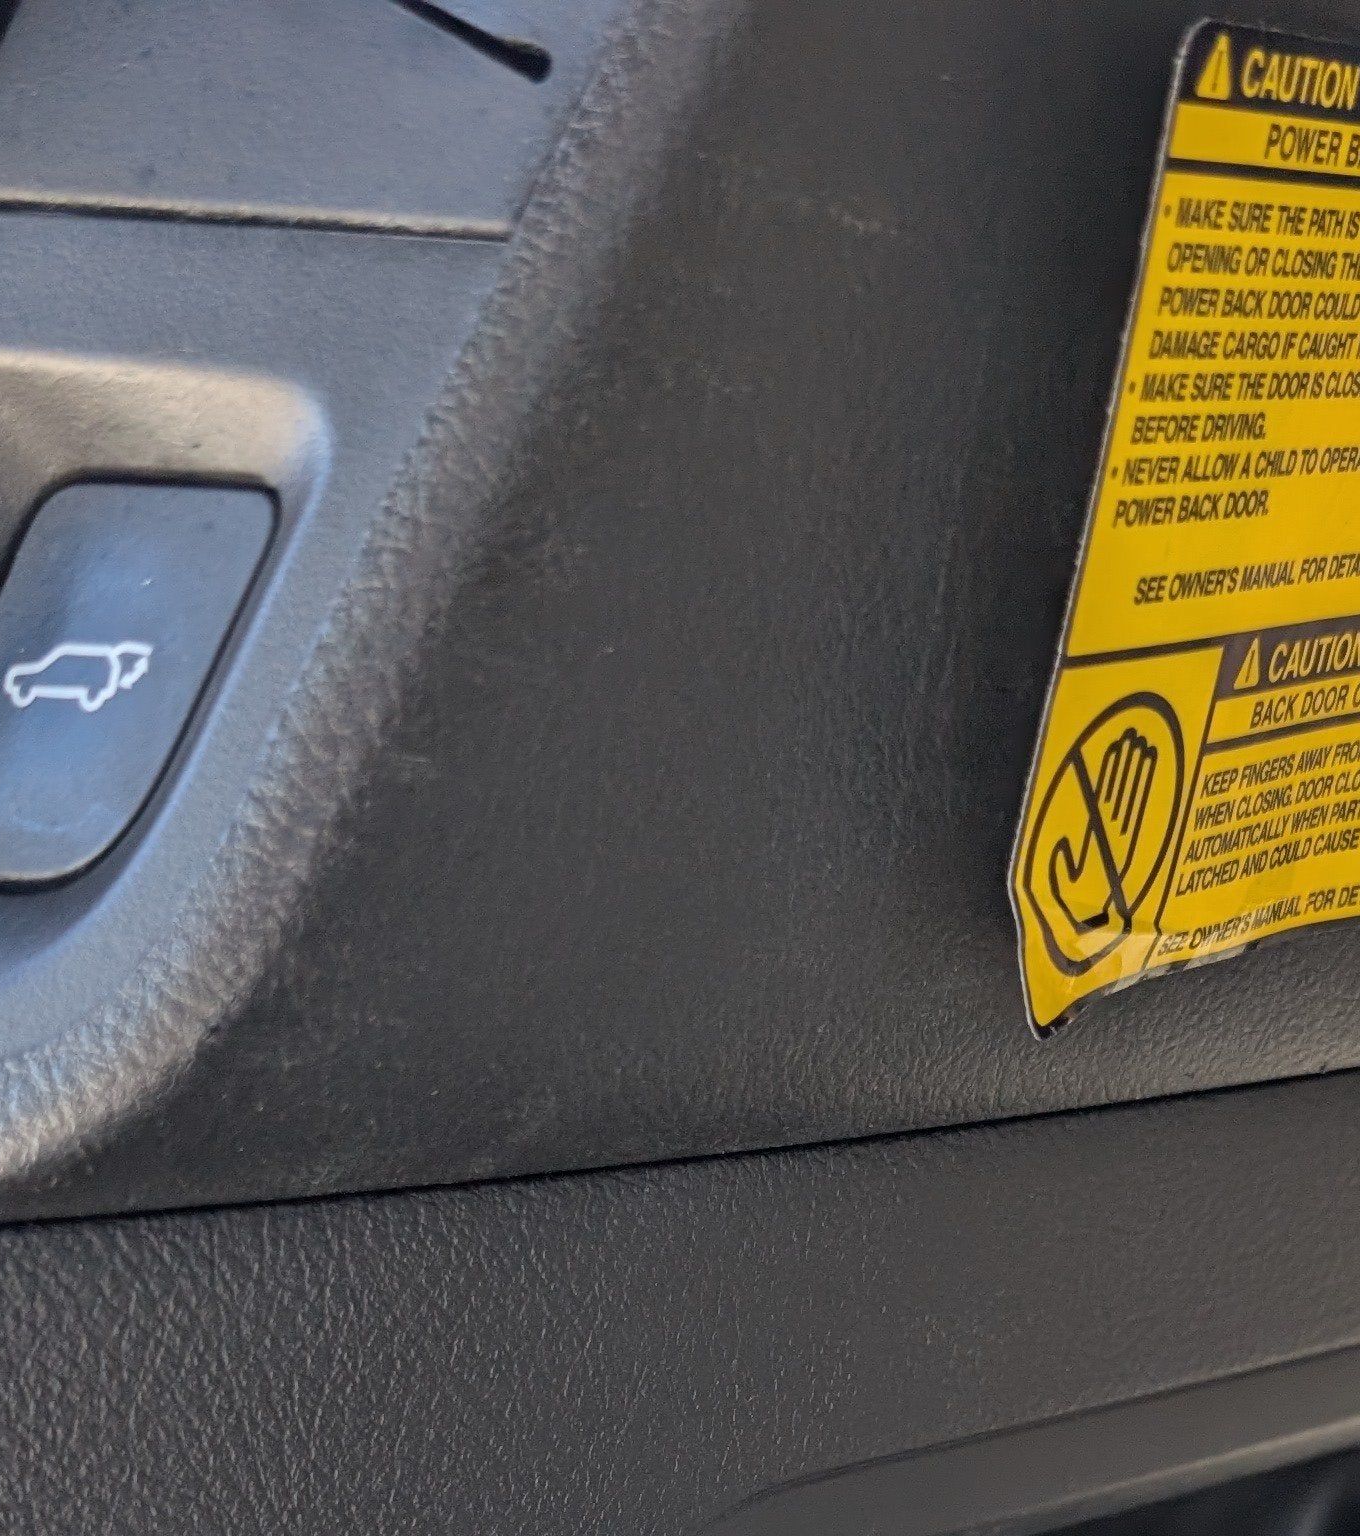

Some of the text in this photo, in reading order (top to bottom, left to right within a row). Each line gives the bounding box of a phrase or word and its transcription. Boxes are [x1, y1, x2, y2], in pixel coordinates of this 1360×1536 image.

[1264, 123, 1343, 166] POWER
[1175, 198, 1225, 230] MAKE
[1227, 203, 1273, 234] SURE
[1277, 206, 1305, 236] THE
[1307, 209, 1343, 238] PATH
[1345, 211, 1360, 239] IS
[1167, 243, 1242, 275] OPENING
[1244, 247, 1269, 275] OR
[1271, 248, 1338, 280] CLOSING
[1157, 287, 1216, 317] POWER
[1217, 288, 1266, 319] BACK
[1267, 291, 1310, 319] DOOR
[1312, 292, 1360, 320] COULD
[1148, 330, 1220, 359] DAMAGE
[1222, 332, 1280, 359] CARGO
[1282, 332, 1296, 359] IF
[1297, 332, 1357, 359] CAUGHT
[1140, 372, 1189, 401] MAKE
[1191, 372, 1234, 401] SURE
[1237, 372, 1265, 400] THE
[1266, 372, 1309, 400] DOOR
[1310, 372, 1324, 399] IS
[1130, 415, 1200, 445] BEFORE
[1121, 456, 1179, 486] NEVER
[1180, 451, 1236, 483] ALLOW
[1238, 451, 1251, 480] A
[1253, 448, 1298, 480] CHILD
[1298, 447, 1318, 477] TO
[1112, 497, 1176, 528] POWER
[1176, 494, 1221, 523] BACK
[1133, 576, 1168, 606] SEE
[1168, 568, 1239, 601] OWNER'S
[1239, 560, 1296, 594] MANUAL
[1297, 556, 1326, 584] FOR
[1249, 699, 1297, 729] BACK
[1300, 685, 1349, 719] DOOR
[1200, 768, 1239, 799] KEEP
[1239, 755, 1294, 791] FINGERS
[1294, 747, 1333, 777] AWAY
[1193, 803, 1236, 831] WHEN
[1295, 779, 1336, 807] DOOR
[1183, 813, 1292, 866] AUTOMATICALLY
[1290, 804, 1329, 834] WHEN
[1175, 864, 1240, 898] LATCHED
[1240, 853, 1269, 880] AND
[1268, 840, 1312, 872] COULD
[1312, 828, 1360, 860] CAUSE
[1252, 896, 1303, 928] MANUAL
[1305, 888, 1335, 916] FOR
